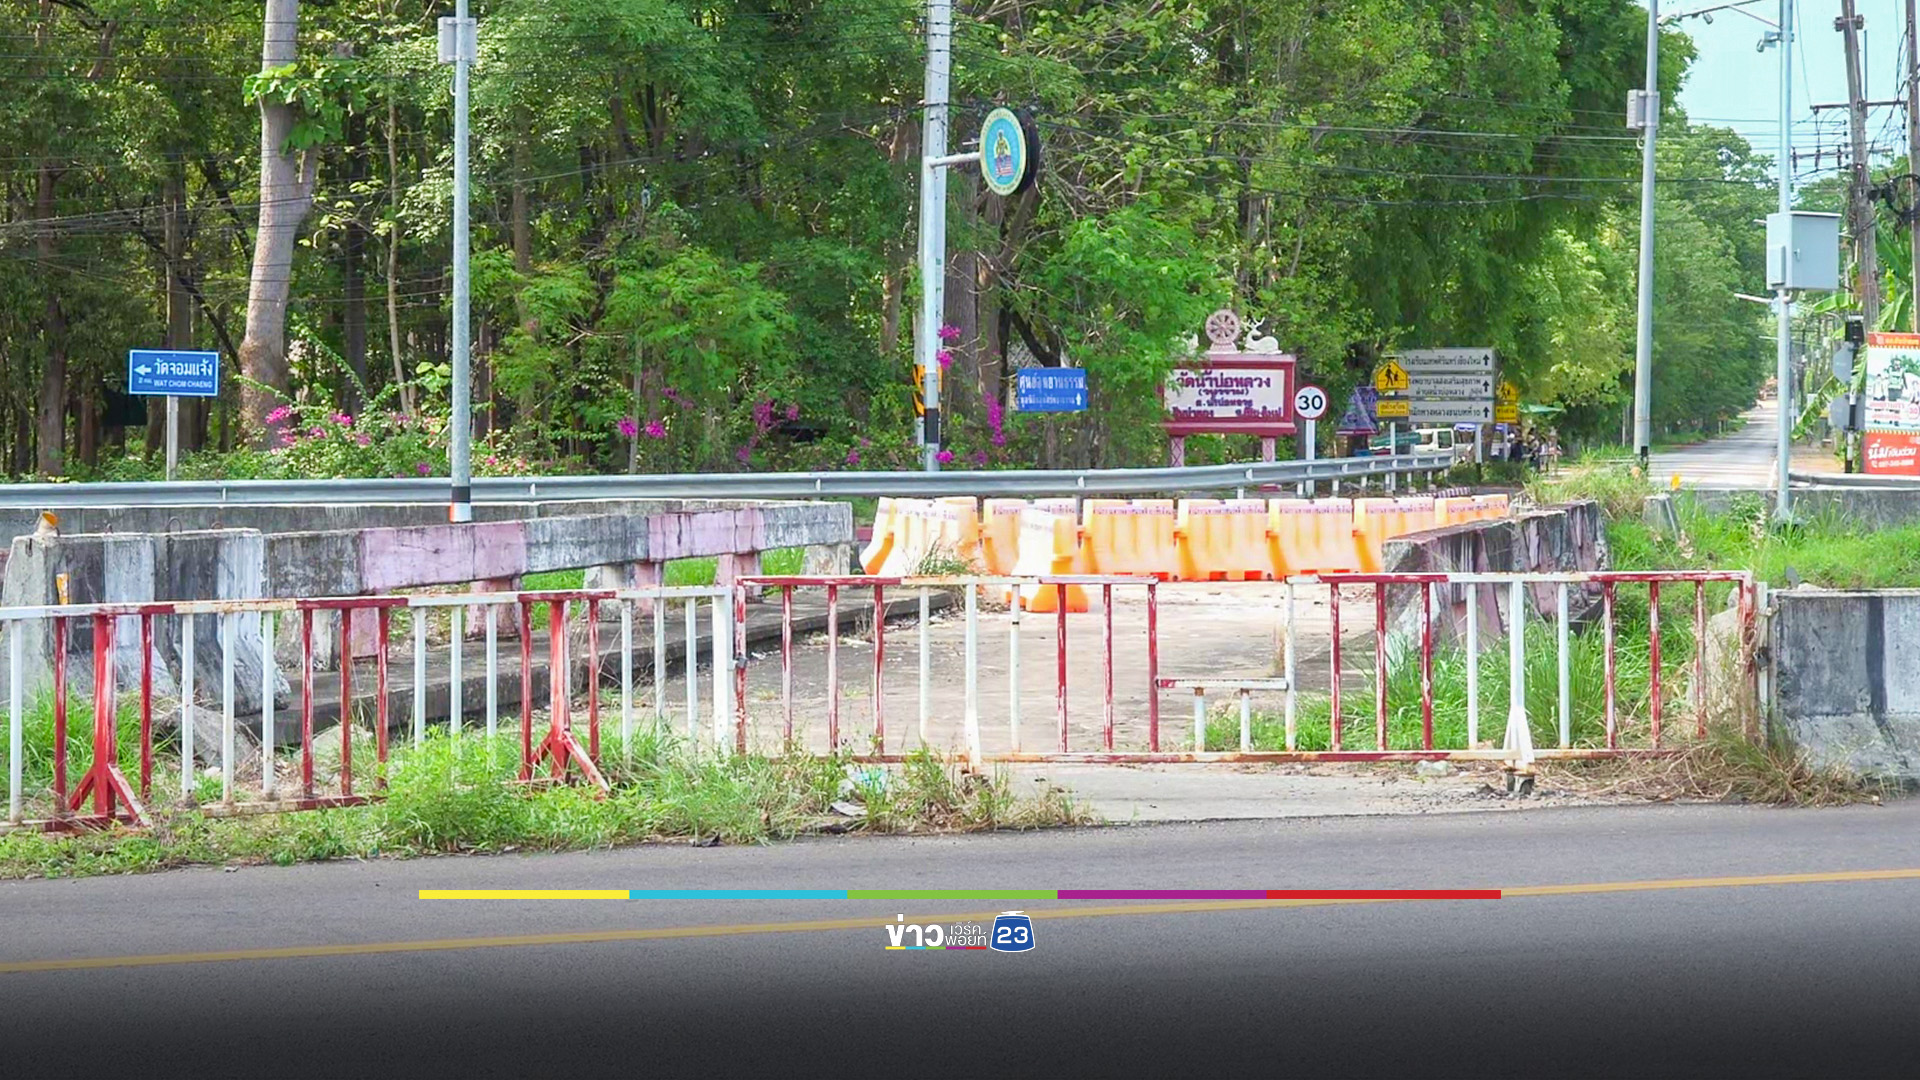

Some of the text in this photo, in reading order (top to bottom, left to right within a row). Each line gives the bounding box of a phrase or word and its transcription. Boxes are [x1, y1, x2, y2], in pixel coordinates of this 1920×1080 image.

[154, 357, 213, 376] วัดจอมแจ้ง
[153, 379, 168, 387] WAT
[1298, 395, 1323, 410] 30
